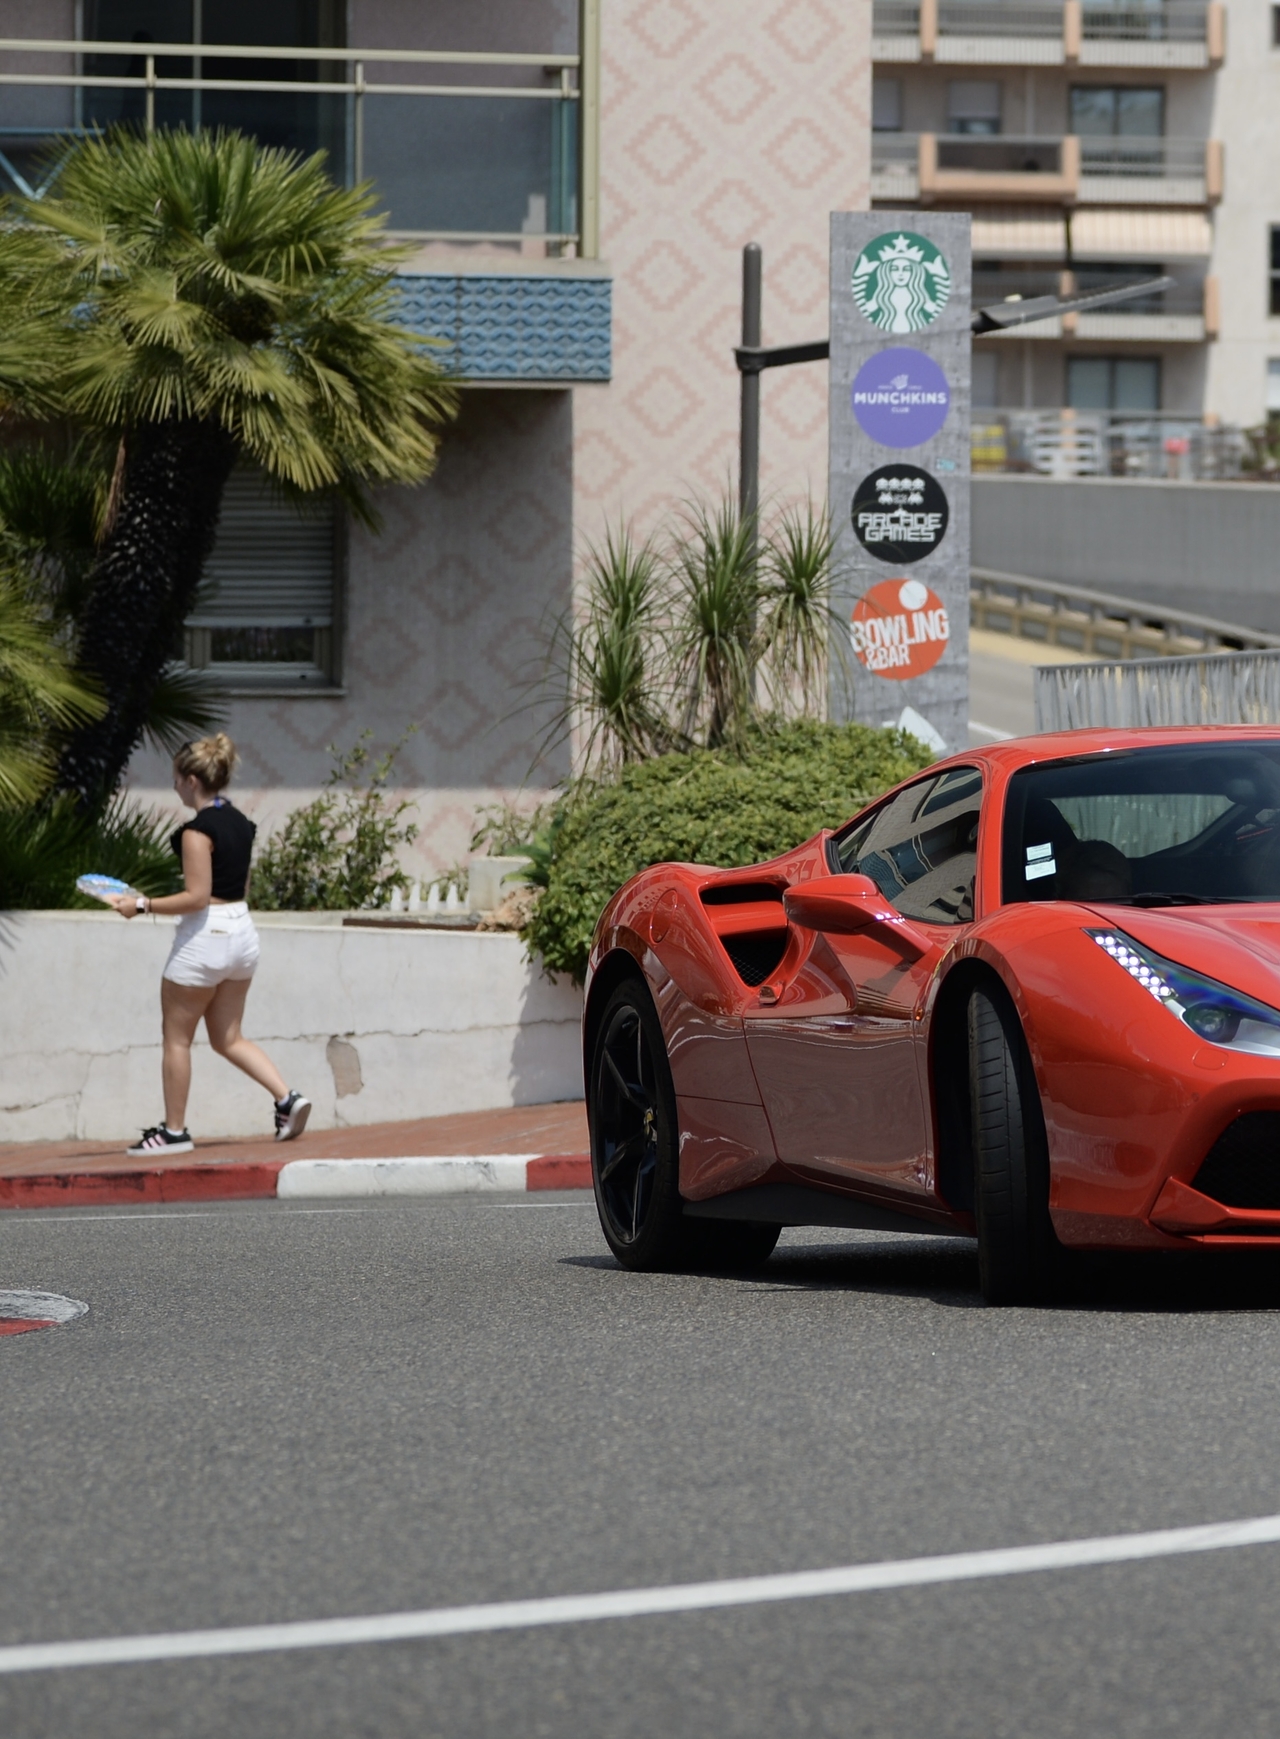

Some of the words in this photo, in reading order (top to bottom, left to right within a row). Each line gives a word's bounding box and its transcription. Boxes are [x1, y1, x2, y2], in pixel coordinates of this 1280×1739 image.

[854, 392, 947, 404] MUNCHKINS
[858, 512, 942, 528] ARCADE
[864, 526, 936, 542] GAMES
[851, 608, 950, 652] BOWLING
[866, 644, 911, 670] &BAR
